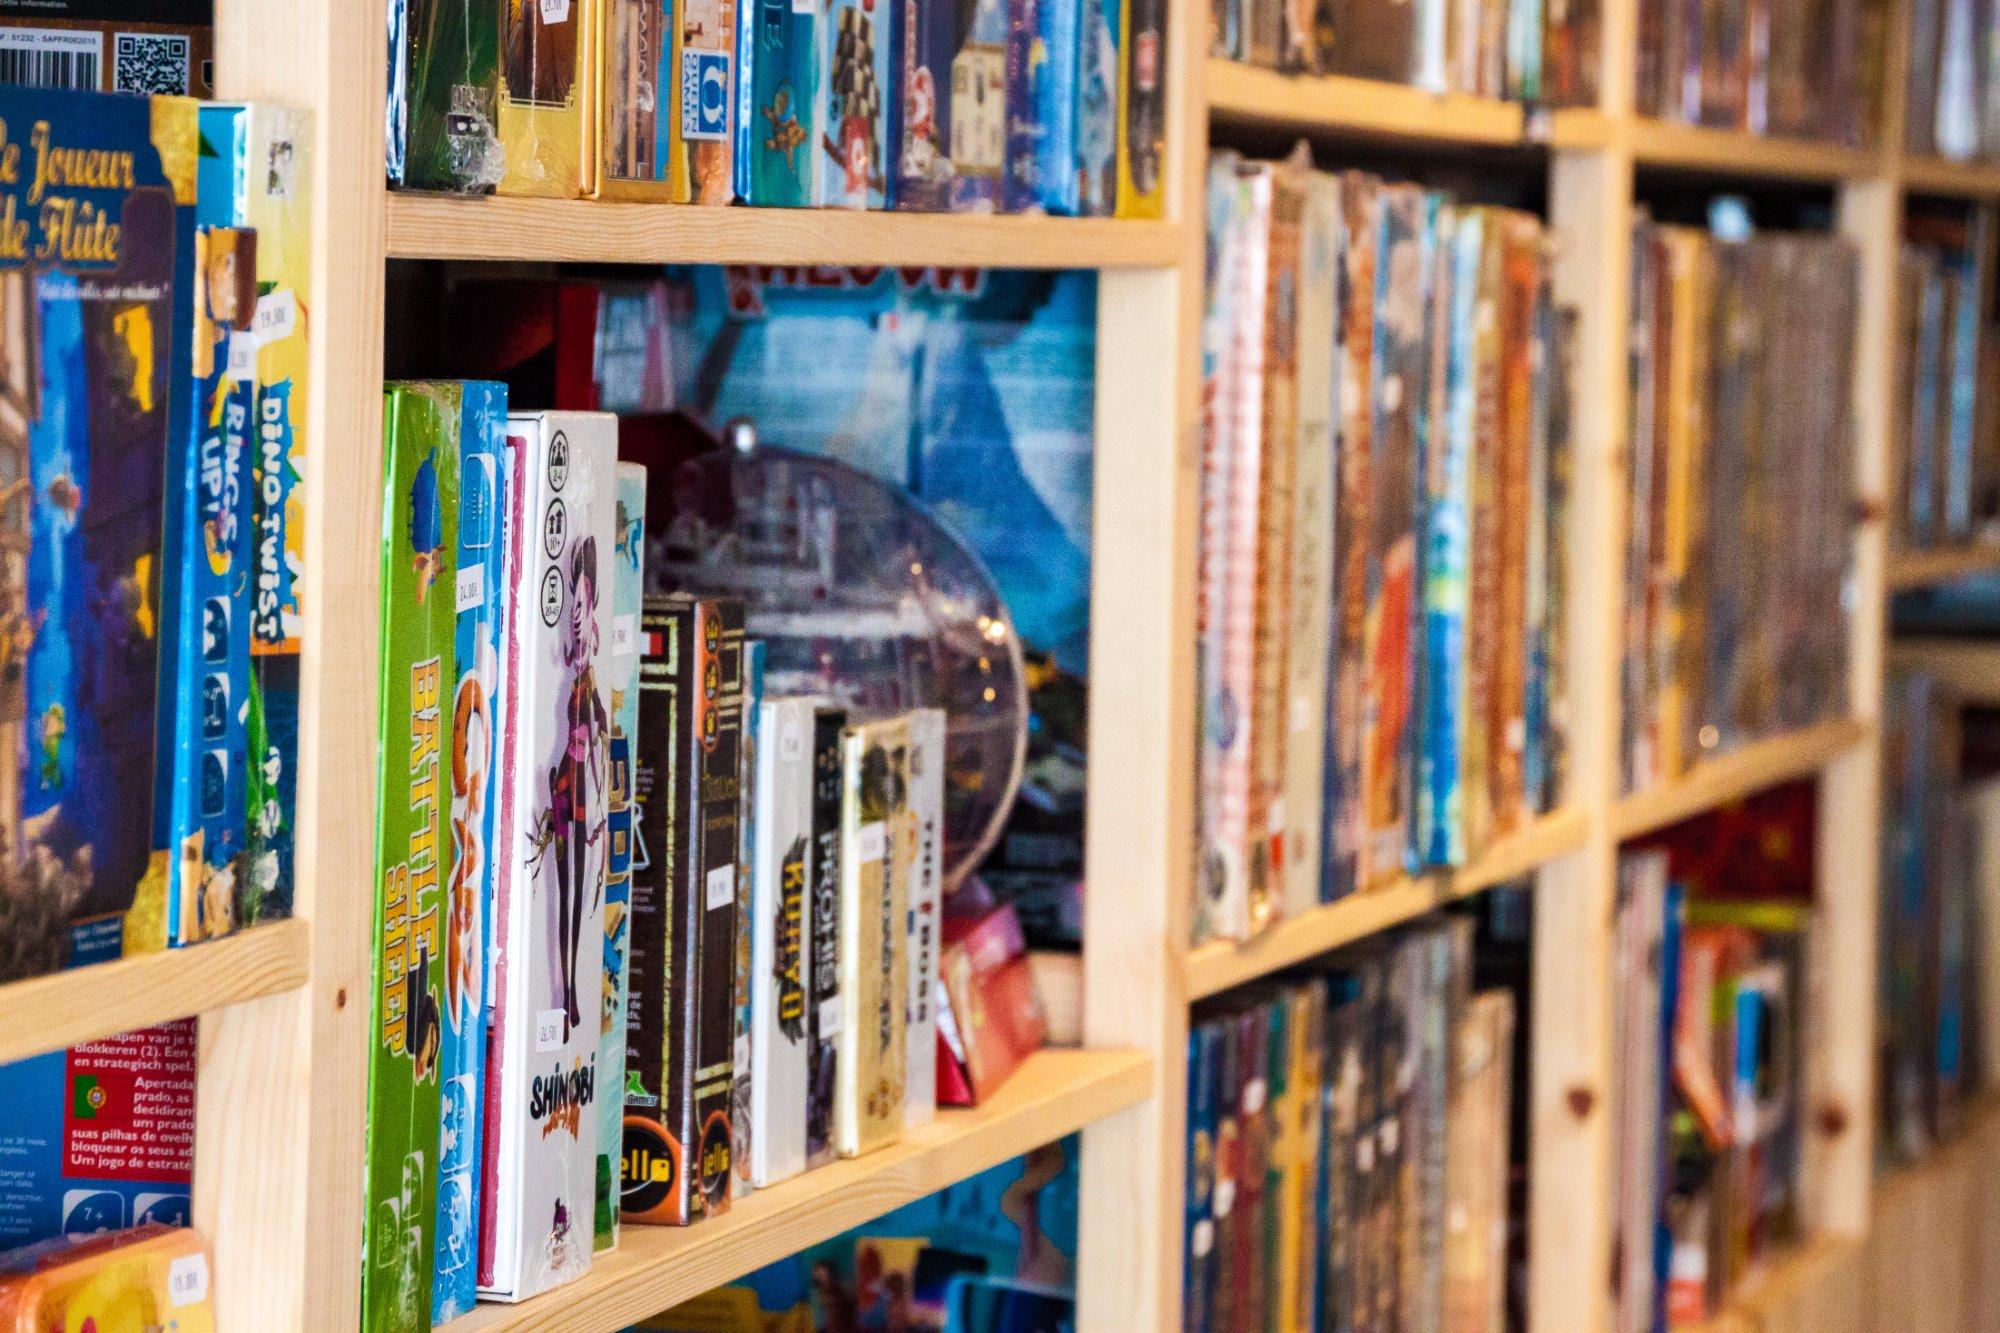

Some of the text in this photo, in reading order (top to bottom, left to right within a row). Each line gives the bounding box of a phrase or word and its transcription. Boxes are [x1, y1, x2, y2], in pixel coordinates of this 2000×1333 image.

[691, 54, 699, 133] QUEEN
[410, 655, 441, 970] BATTLE
[382, 861, 408, 1058] SHEEP
[165, 1047, 187, 1057] Een
[74, 1058, 193, 1073] en strategisch spel.
[133, 1092, 189, 1104] prado, as
[133, 1119, 153, 1128] um
[72, 1130, 98, 1139] suas
[102, 1129, 138, 1141] pilhas
[141, 1131, 156, 1140] de
[71, 1141, 127, 1155] bloquear
[130, 1145, 144, 1155] os
[148, 1146, 174, 1156] seus
[71, 1154, 95, 1165] Um
[98, 1156, 125, 1169] jogo
[128, 1158, 144, 1168] de
[621, 1149, 669, 1182] ello
